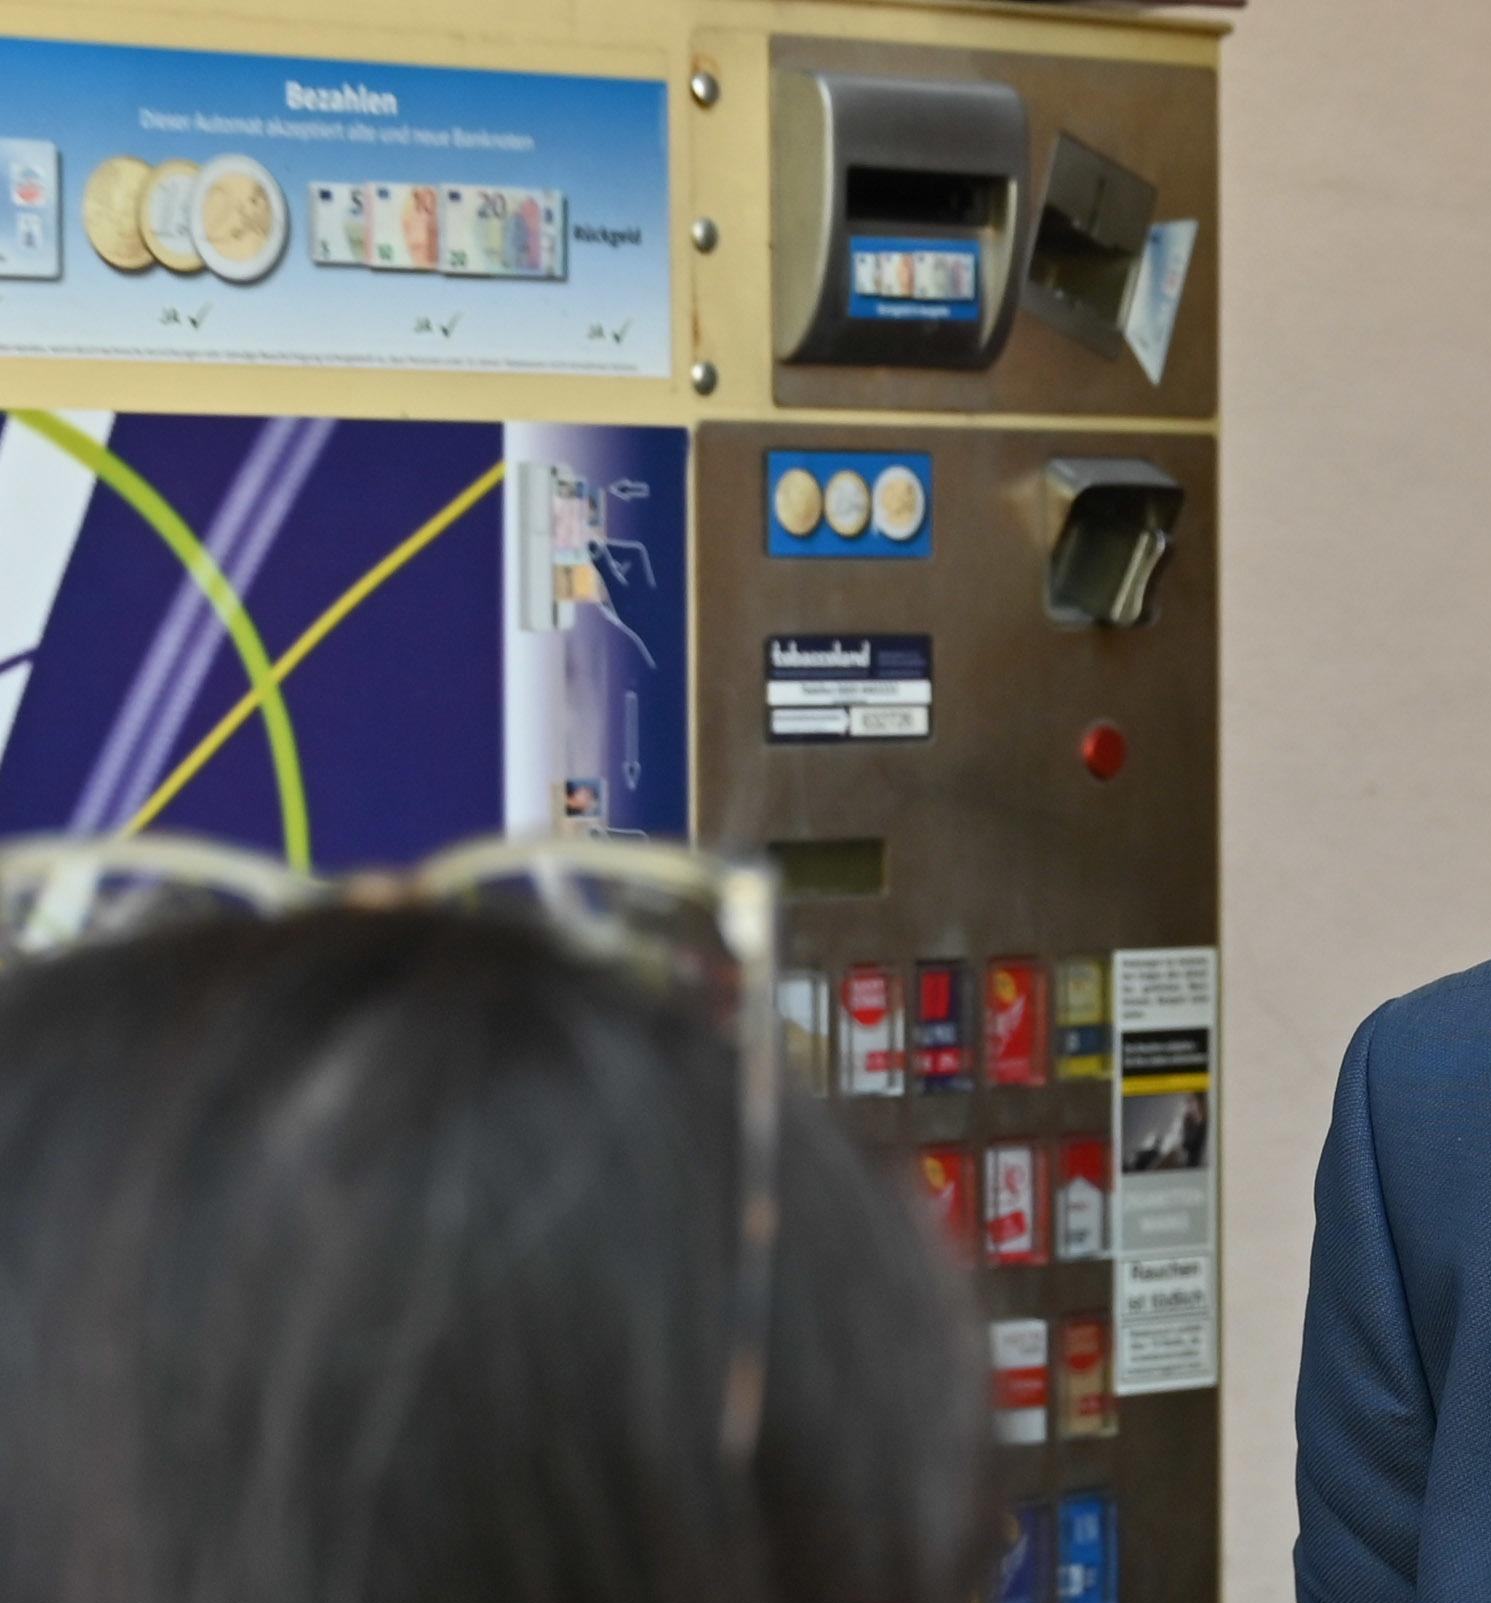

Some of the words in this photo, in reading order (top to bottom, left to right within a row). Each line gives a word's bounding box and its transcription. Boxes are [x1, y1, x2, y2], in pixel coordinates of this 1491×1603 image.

[285, 79, 398, 116] Bezahlen
[477, 190, 508, 219] 20
[573, 225, 642, 248] Rückgeld
